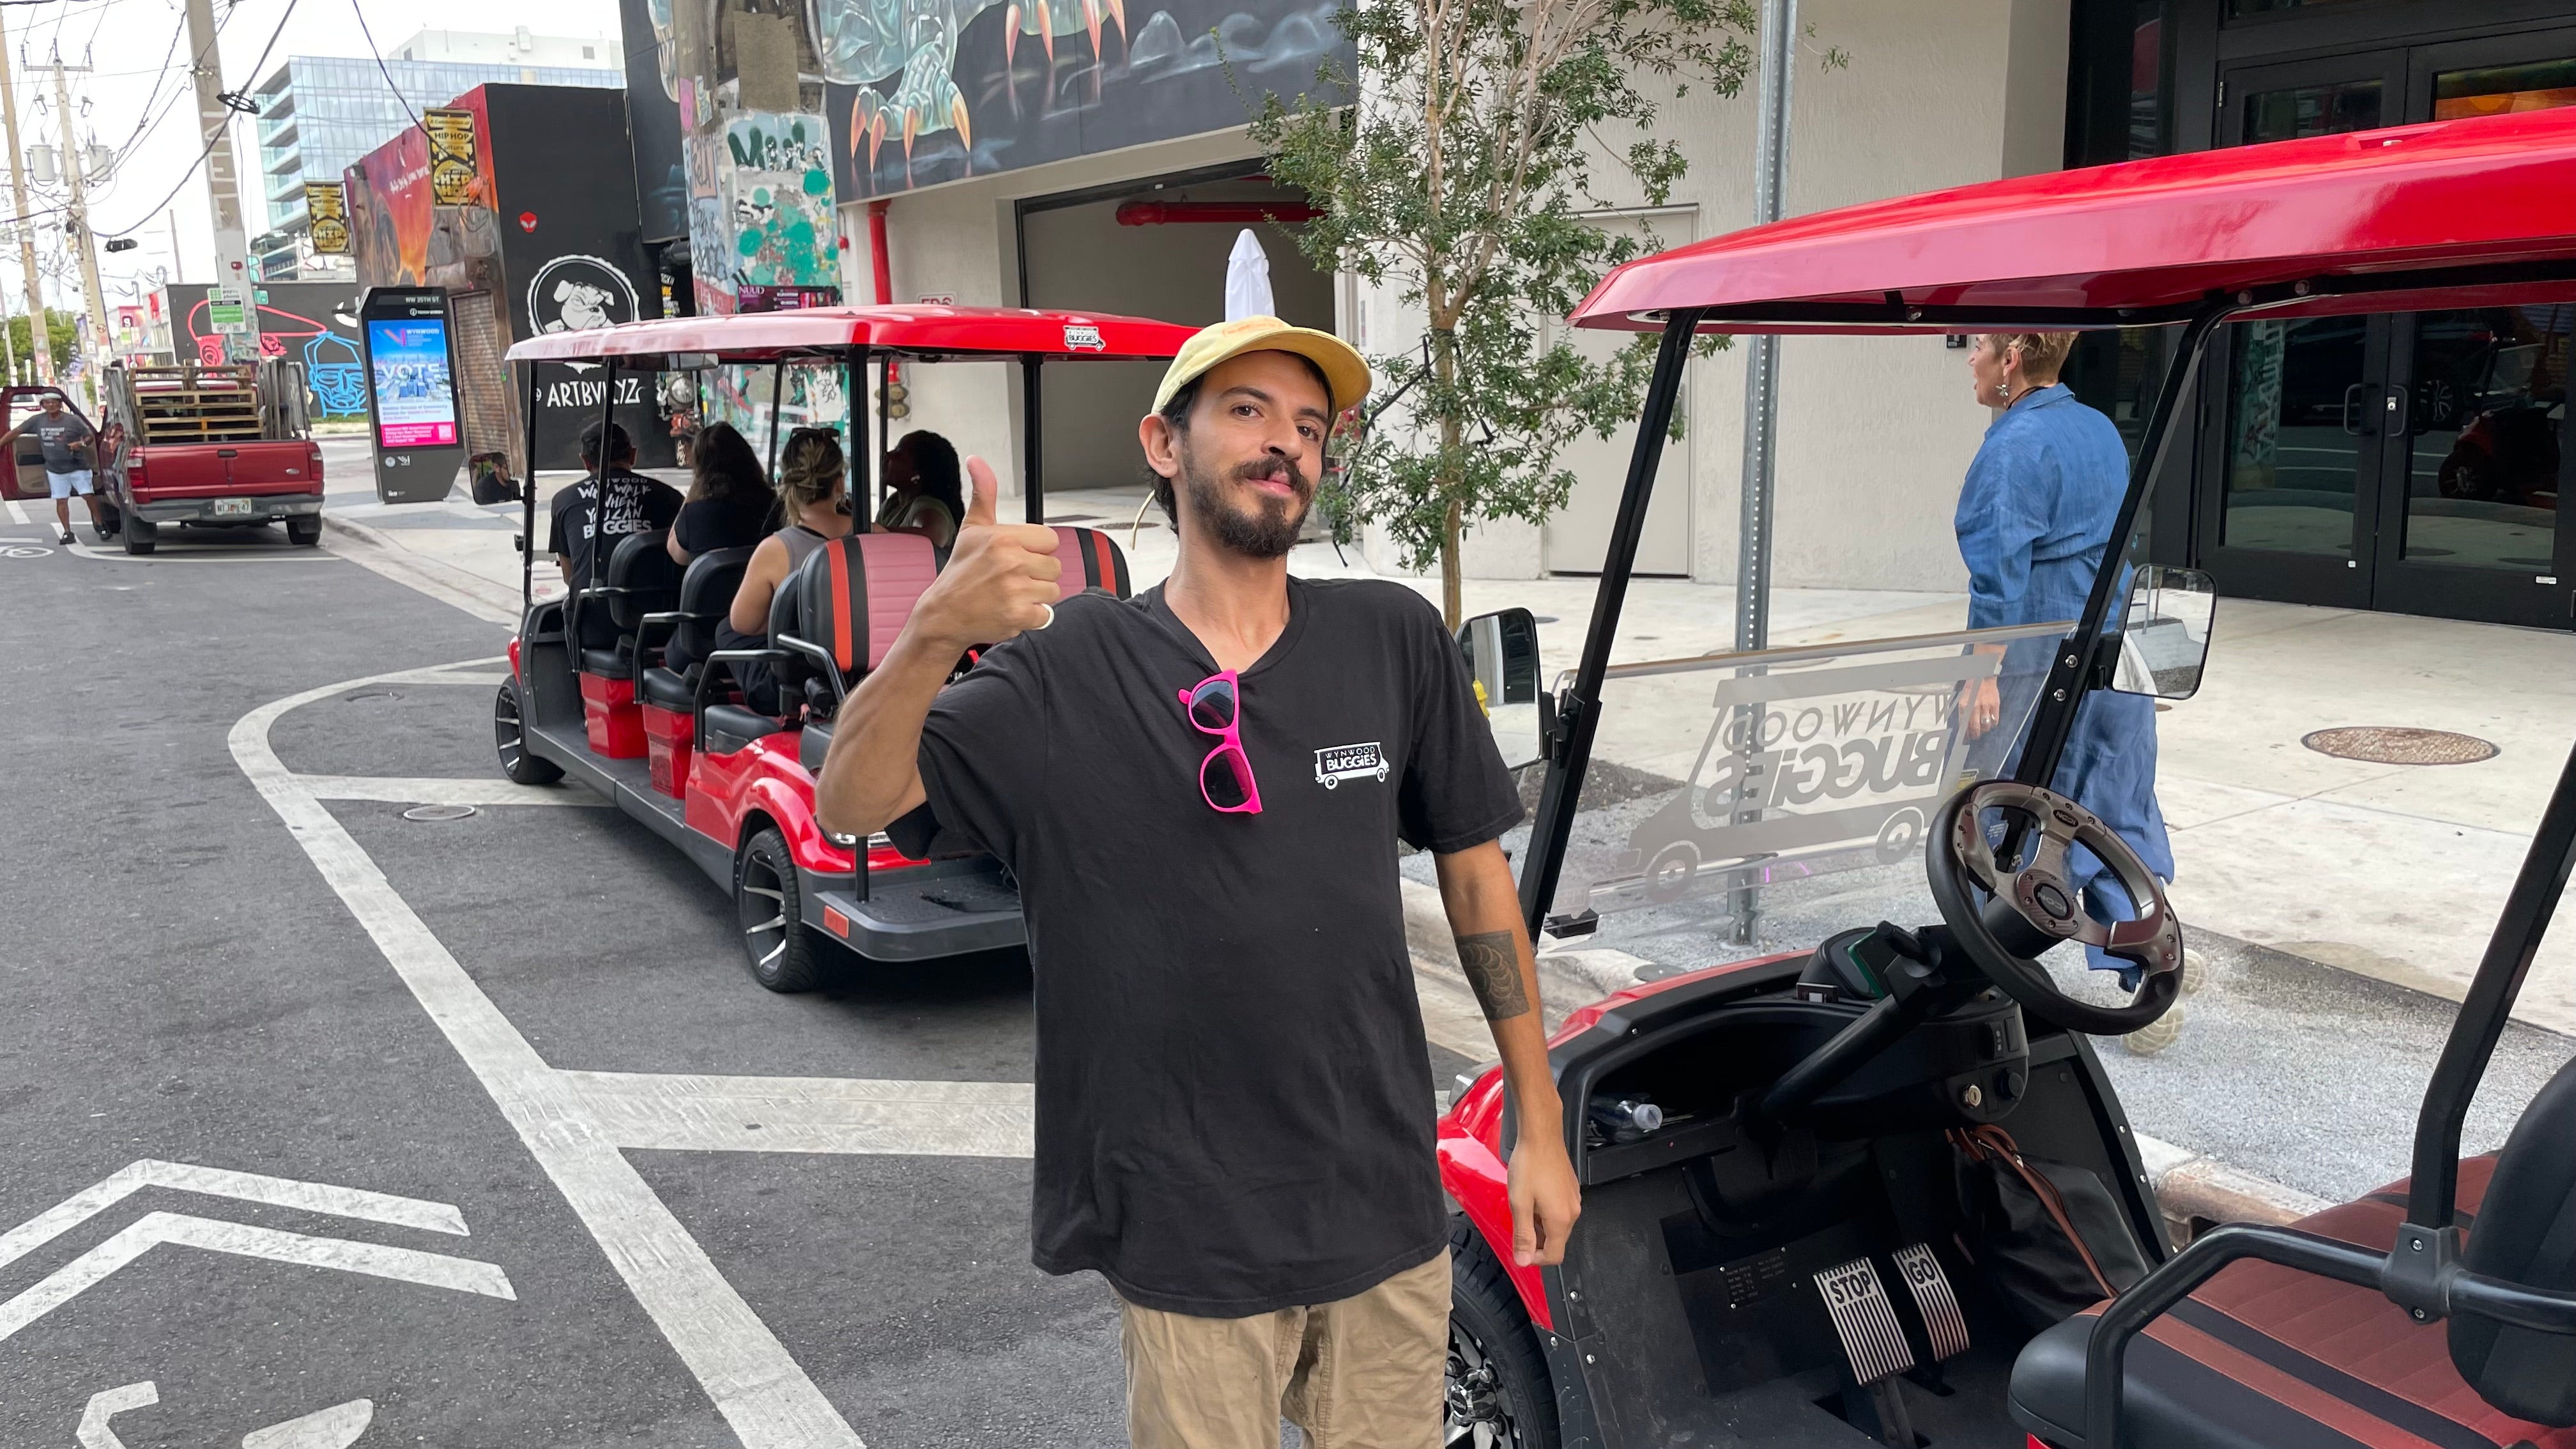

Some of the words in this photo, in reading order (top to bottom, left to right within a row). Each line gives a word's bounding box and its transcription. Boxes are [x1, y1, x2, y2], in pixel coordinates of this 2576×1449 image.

[739, 286, 765, 295] NUUD
[381, 363, 441, 379] VOTE
[583, 519, 652, 539] BGGIES
[1325, 746, 1376, 758] WYNWOOD
[1908, 1258, 1935, 1285] GO
[1830, 1271, 1871, 1304] STOP
